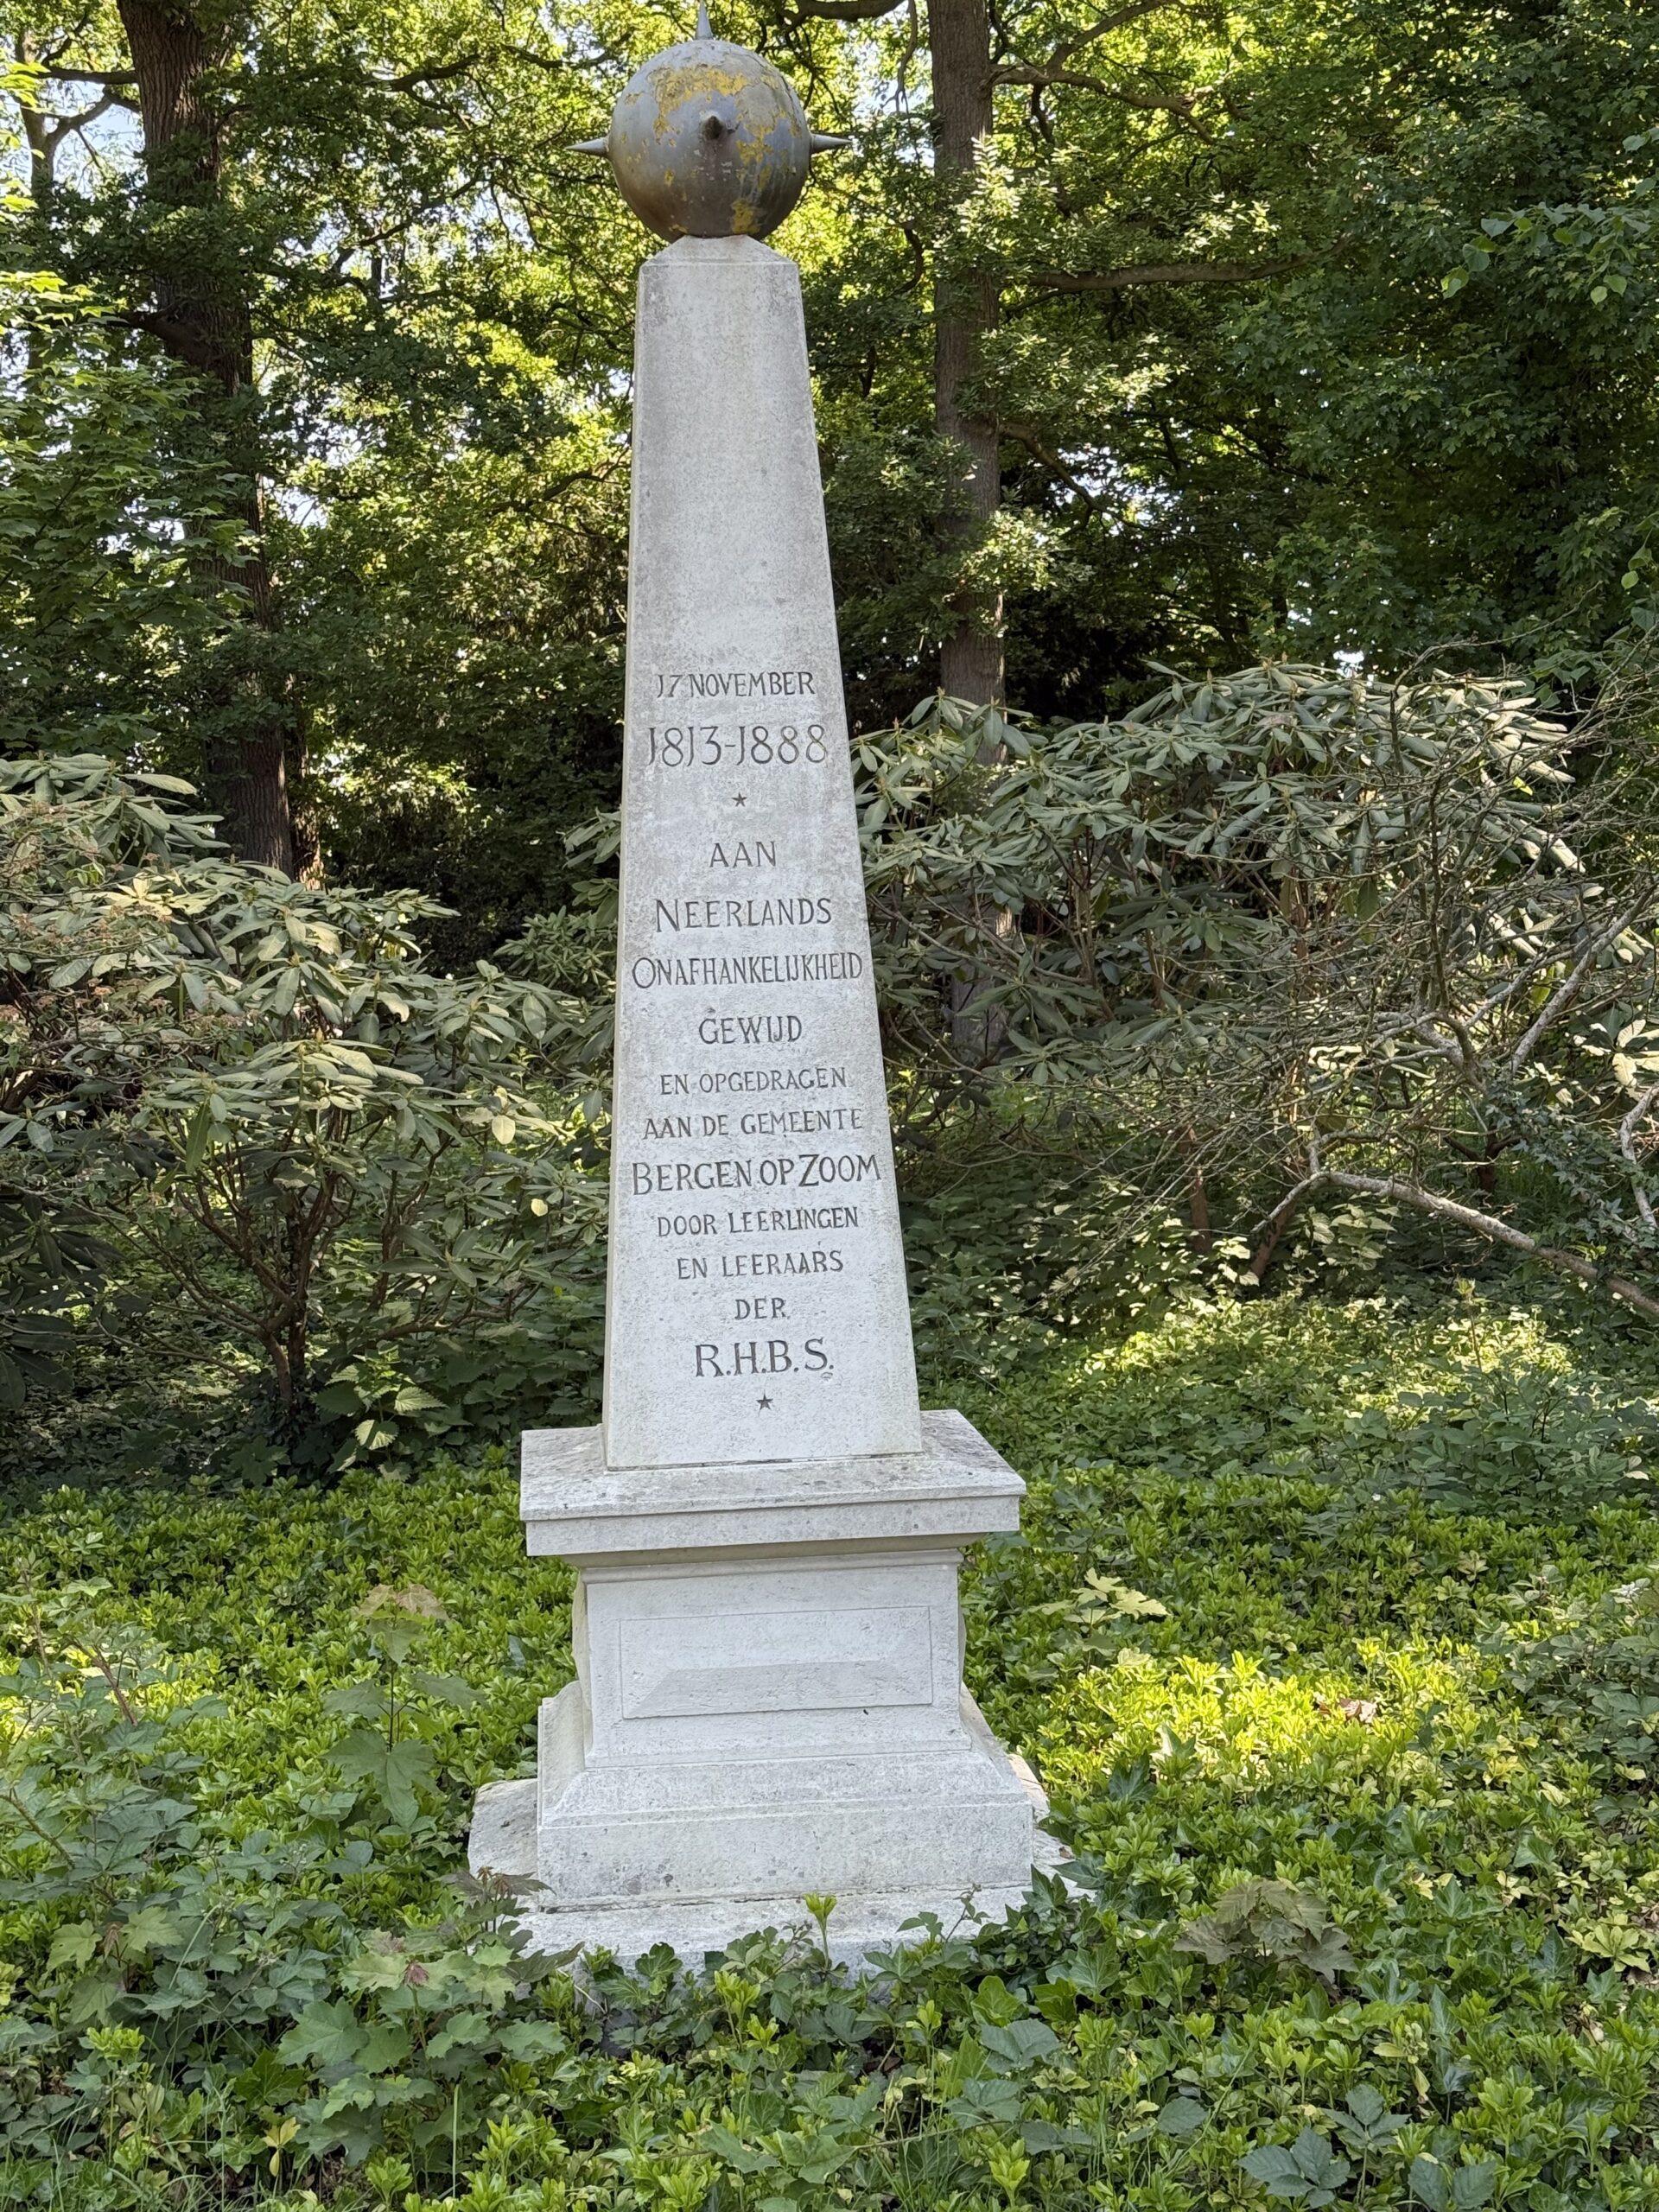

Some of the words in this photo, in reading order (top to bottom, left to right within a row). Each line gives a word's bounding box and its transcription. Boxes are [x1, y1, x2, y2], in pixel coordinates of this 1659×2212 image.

[658, 675, 683, 698] 17
[690, 671, 816, 696] NOVEMBER
[648, 724, 828, 766] 1813-1888
[709, 841, 777, 868] AAN
[655, 898, 832, 932] NEERLANDS
[632, 952, 862, 988] ONAFHANKELIJKHEID
[698, 1015, 802, 1045] GEWIJD
[660, 1074, 690, 1095] EN
[699, 1067, 847, 1093] OPGEDRAGEN
[644, 1117, 692, 1140] AAN
[702, 1115, 728, 1136] DE
[741, 1109, 863, 1135] GEMEENTE
[632, 1160, 752, 1195] BERGEN
[760, 1159, 795, 1186] OP
[798, 1154, 881, 1187] ZOOM
[658, 1214, 718, 1237] DOOR
[728, 1207, 859, 1233] LEERLINGEN
[677, 1257, 708, 1280] EN
[722, 1250, 844, 1277] LEERAARS
[734, 1298, 786, 1320] DER
[695, 1337, 835, 1377] R.H.B.S.
